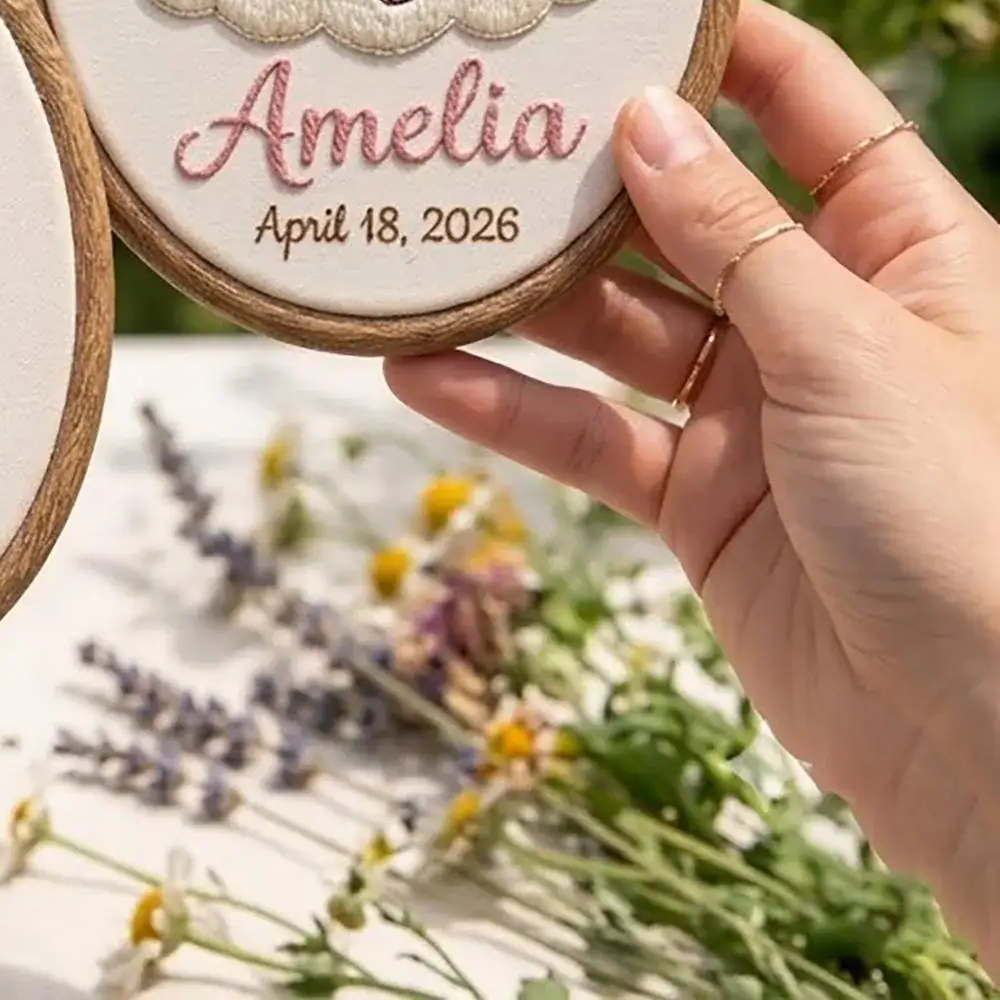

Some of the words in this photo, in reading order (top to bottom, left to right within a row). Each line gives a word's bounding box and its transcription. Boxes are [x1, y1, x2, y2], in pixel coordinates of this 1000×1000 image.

[174, 57, 587, 191] Amelia
[254, 204, 350, 261] April
[360, 206, 407, 248] 18,
[421, 206, 520, 244] 2026
